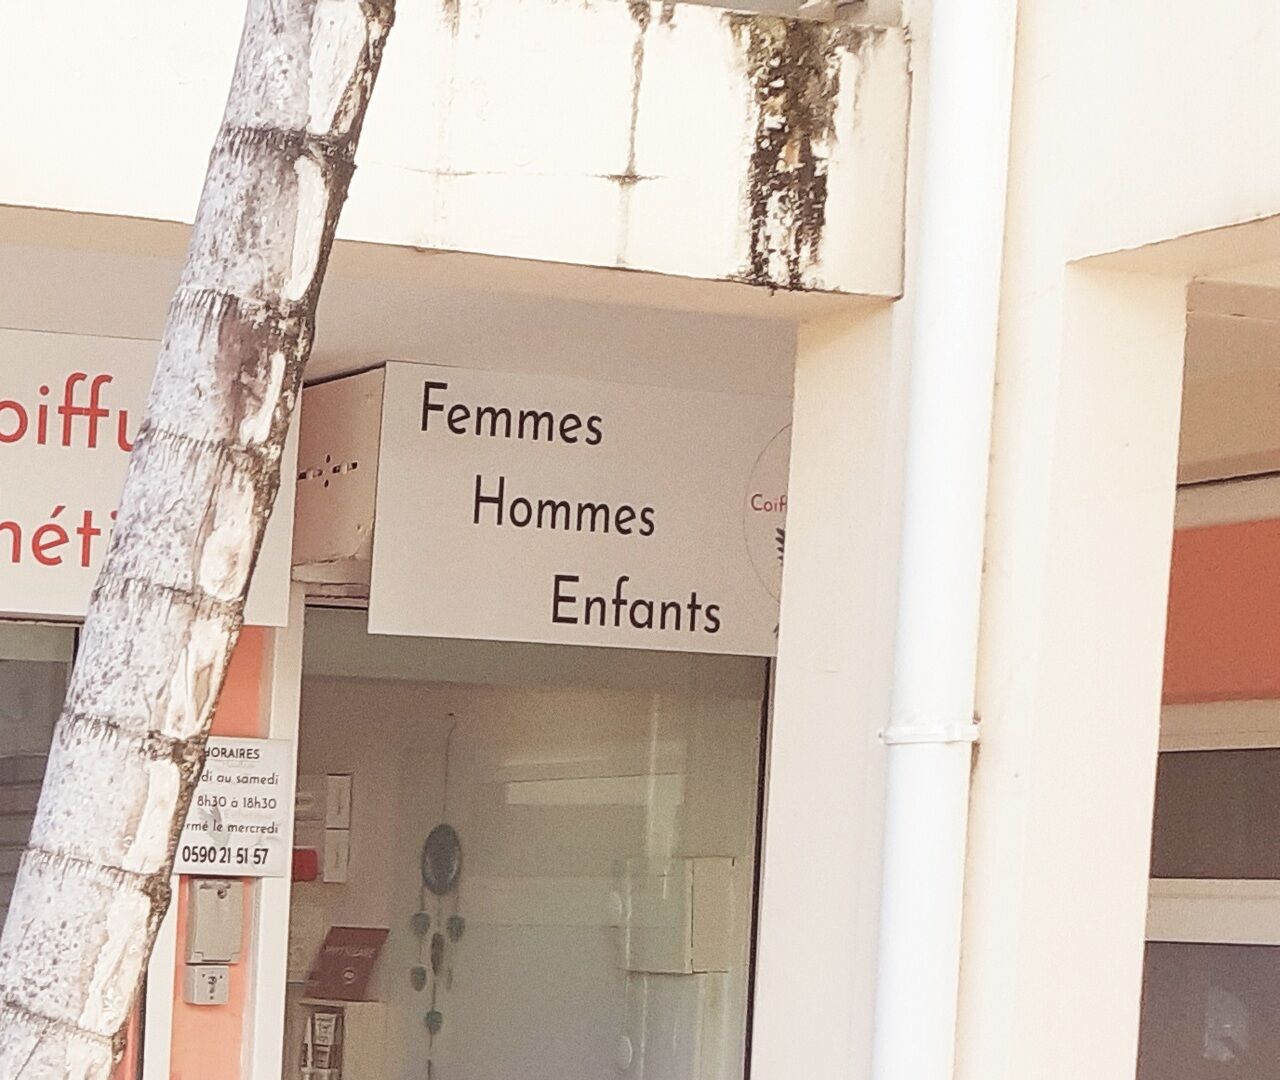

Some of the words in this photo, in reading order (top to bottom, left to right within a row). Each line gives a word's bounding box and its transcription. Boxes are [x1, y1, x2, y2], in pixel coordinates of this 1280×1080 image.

[421, 380, 603, 445] Femmes
[473, 474, 655, 536] Hommes
[552, 574, 721, 634] Enfants
[217, 775, 232, 783] au
[236, 773, 280, 785] samedi
[197, 795, 227, 807] 8h30
[243, 797, 277, 809] 18h30
[182, 820, 209, 831] rmé
[213, 819, 223, 832] le
[228, 821, 278, 834] mercredi
[182, 845, 217, 863] 0590
[219, 847, 231, 863] 21
[236, 848, 248, 864] 51
[253, 848, 269, 865] 57
